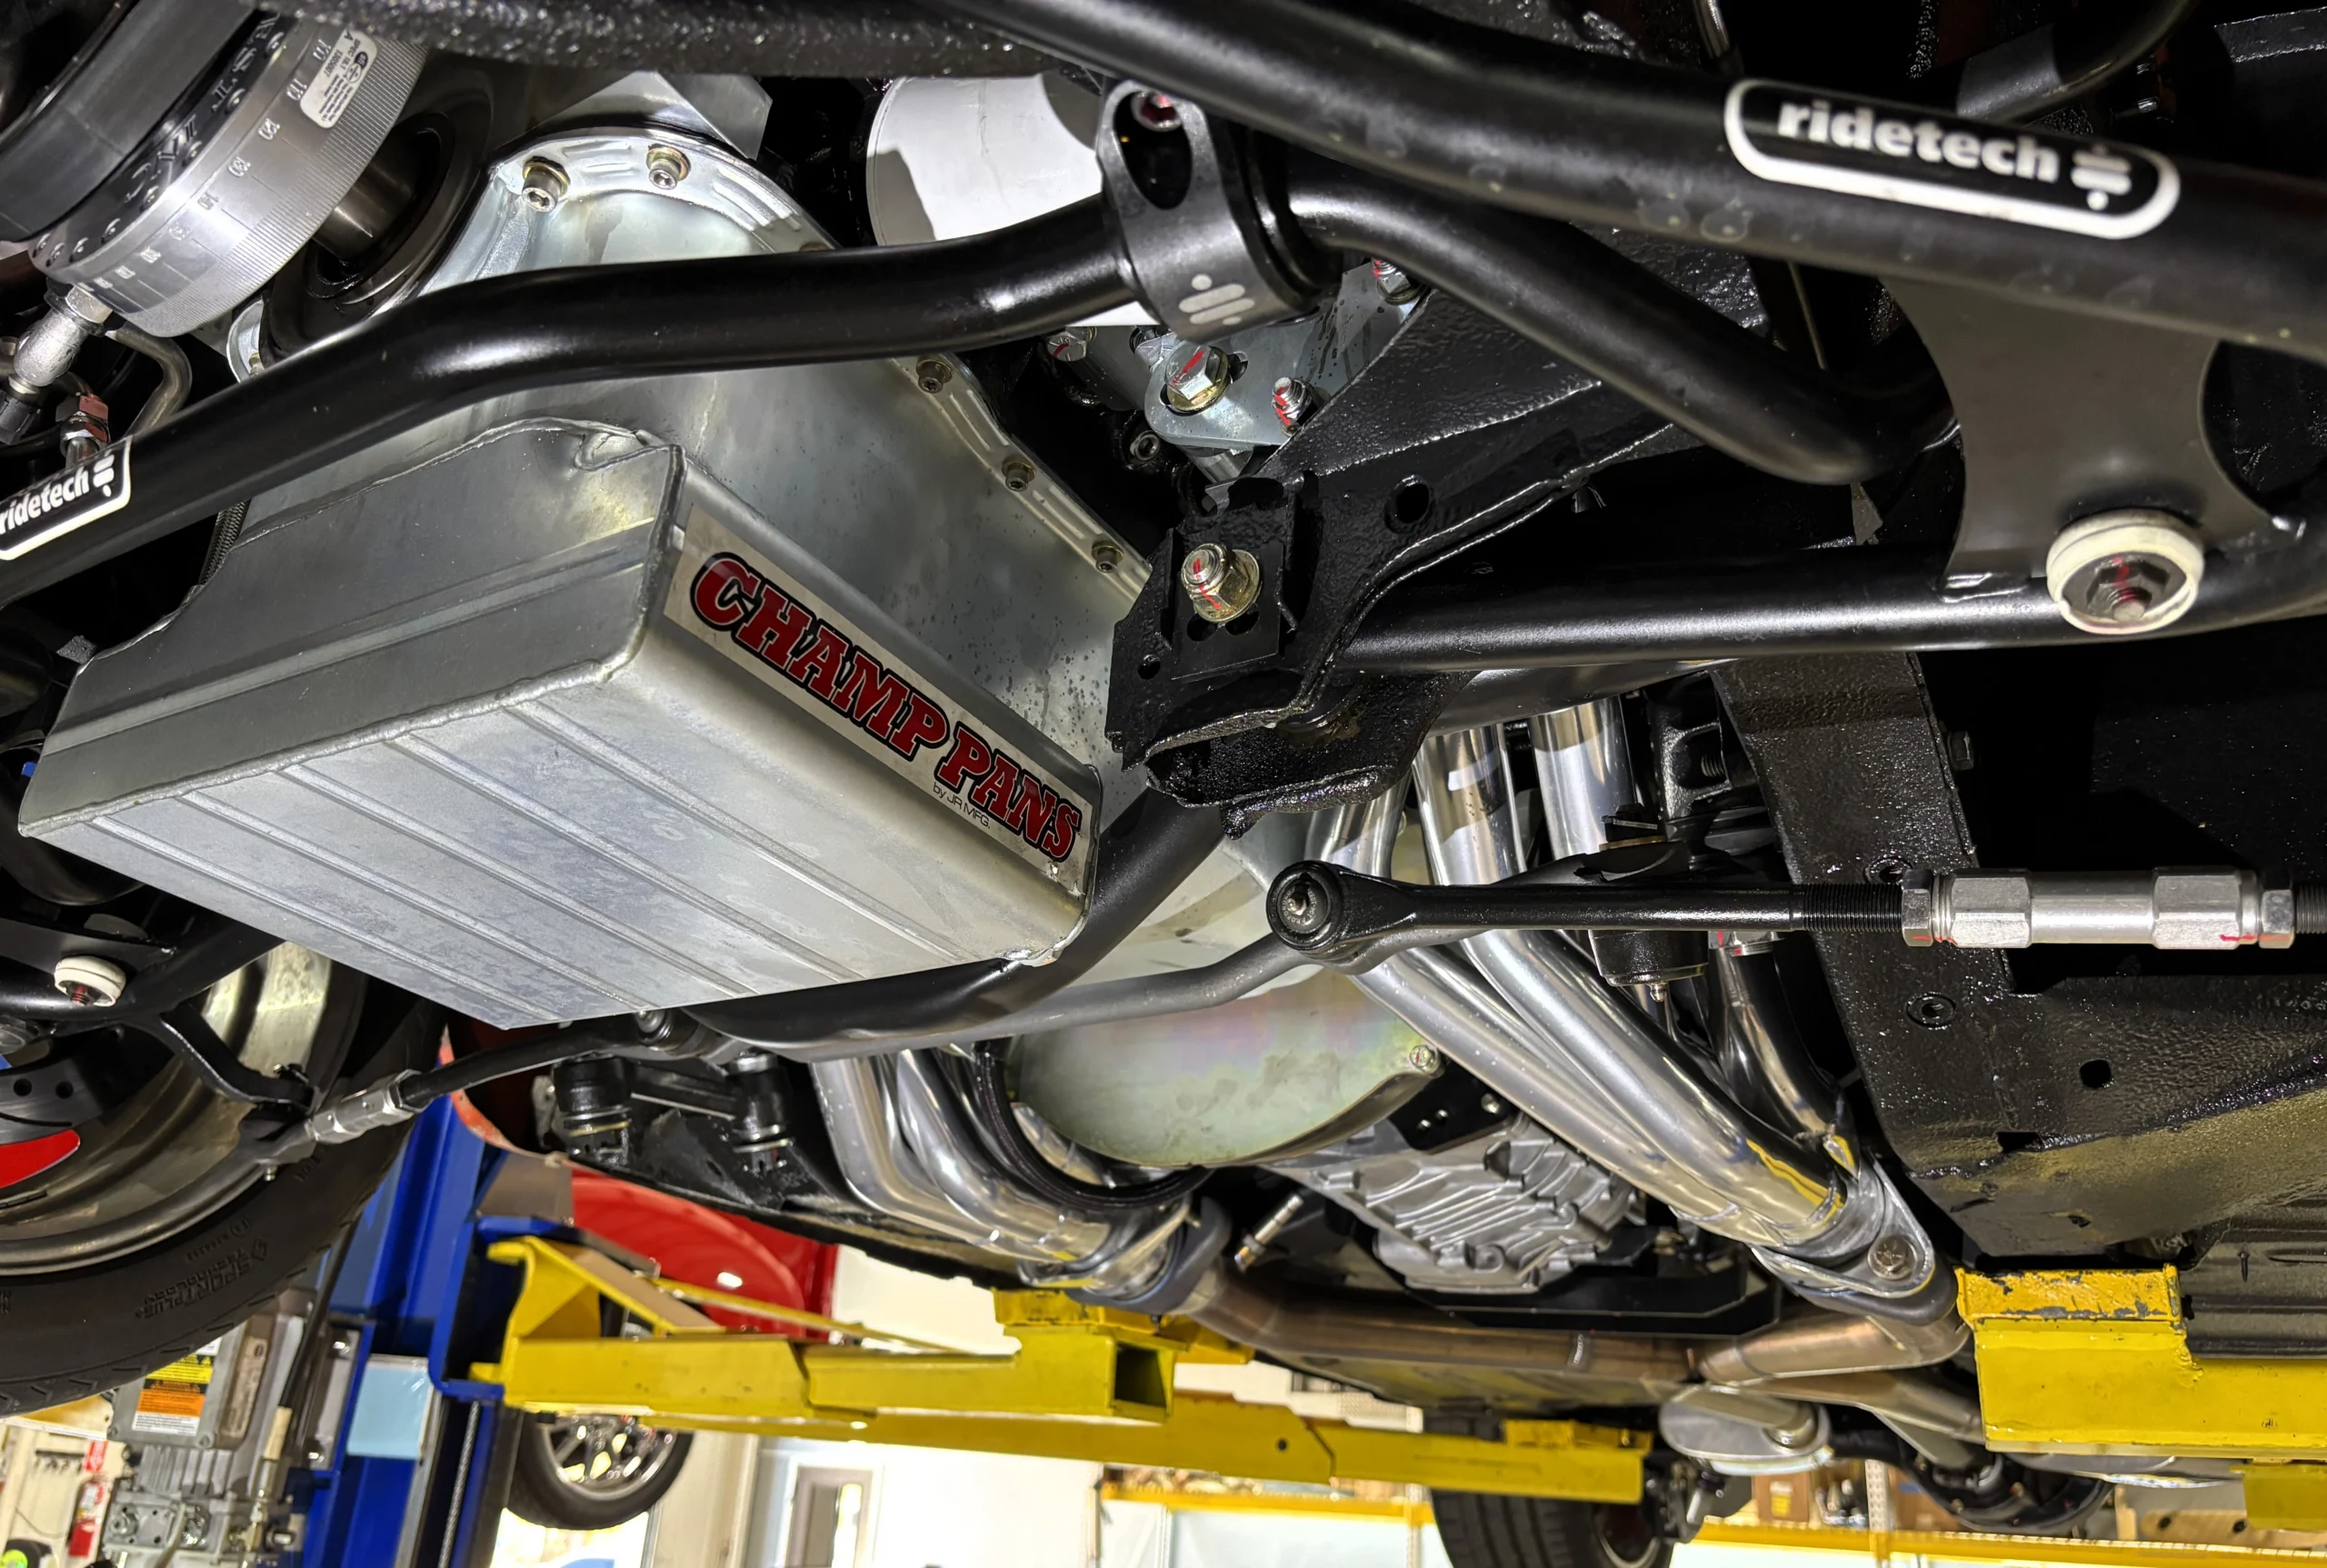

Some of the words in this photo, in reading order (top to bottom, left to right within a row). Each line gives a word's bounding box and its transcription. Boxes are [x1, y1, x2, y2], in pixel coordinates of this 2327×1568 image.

[1777, 99, 2062, 184] ridetech
[0, 465, 90, 535] ridetech
[690, 552, 951, 761] CHAMP
[934, 720, 1082, 862] PANS
[933, 782, 946, 798] by
[947, 794, 962, 809] JR
[964, 803, 991, 828] MFG.
